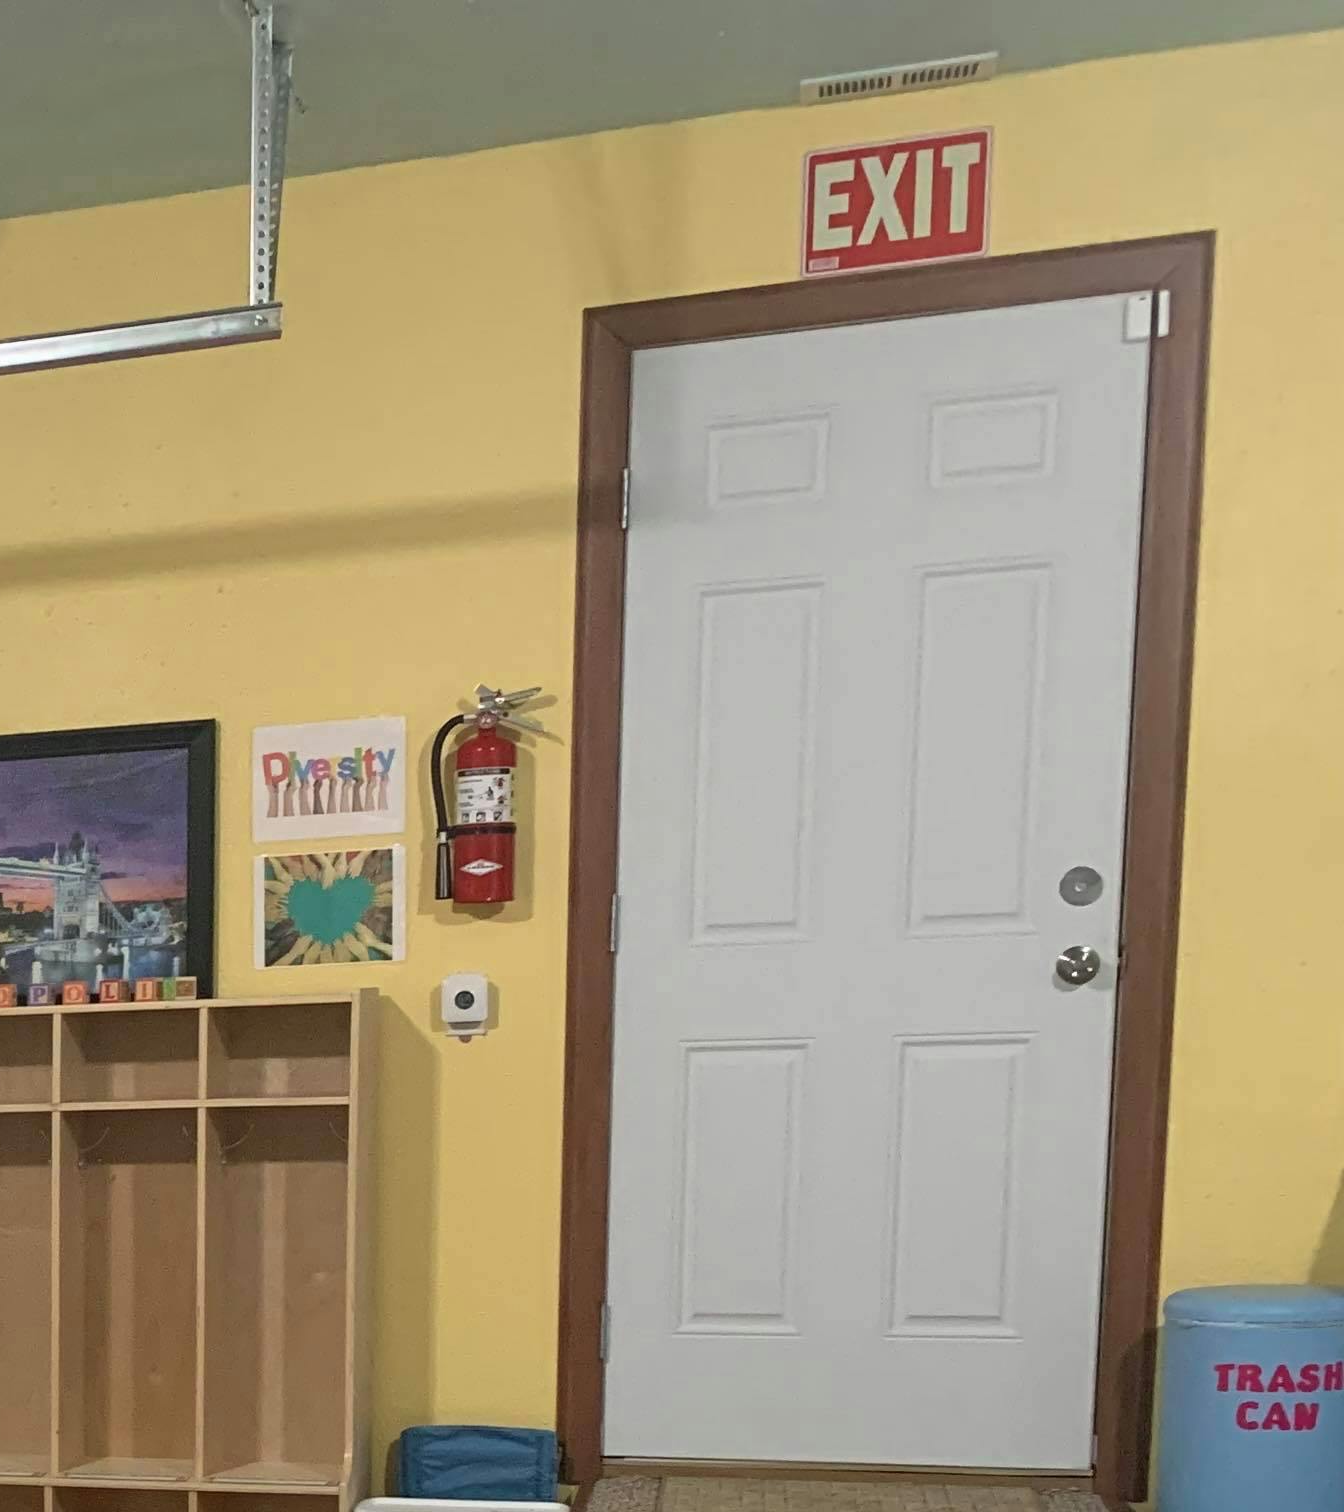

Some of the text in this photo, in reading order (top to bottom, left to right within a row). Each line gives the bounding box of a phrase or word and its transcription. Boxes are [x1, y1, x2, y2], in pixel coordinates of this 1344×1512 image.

[812, 142, 981, 252] EXIT
[262, 747, 396, 787] Diversity
[1214, 1360, 1344, 1393] TRASH
[1235, 1401, 1320, 1431] CAN
